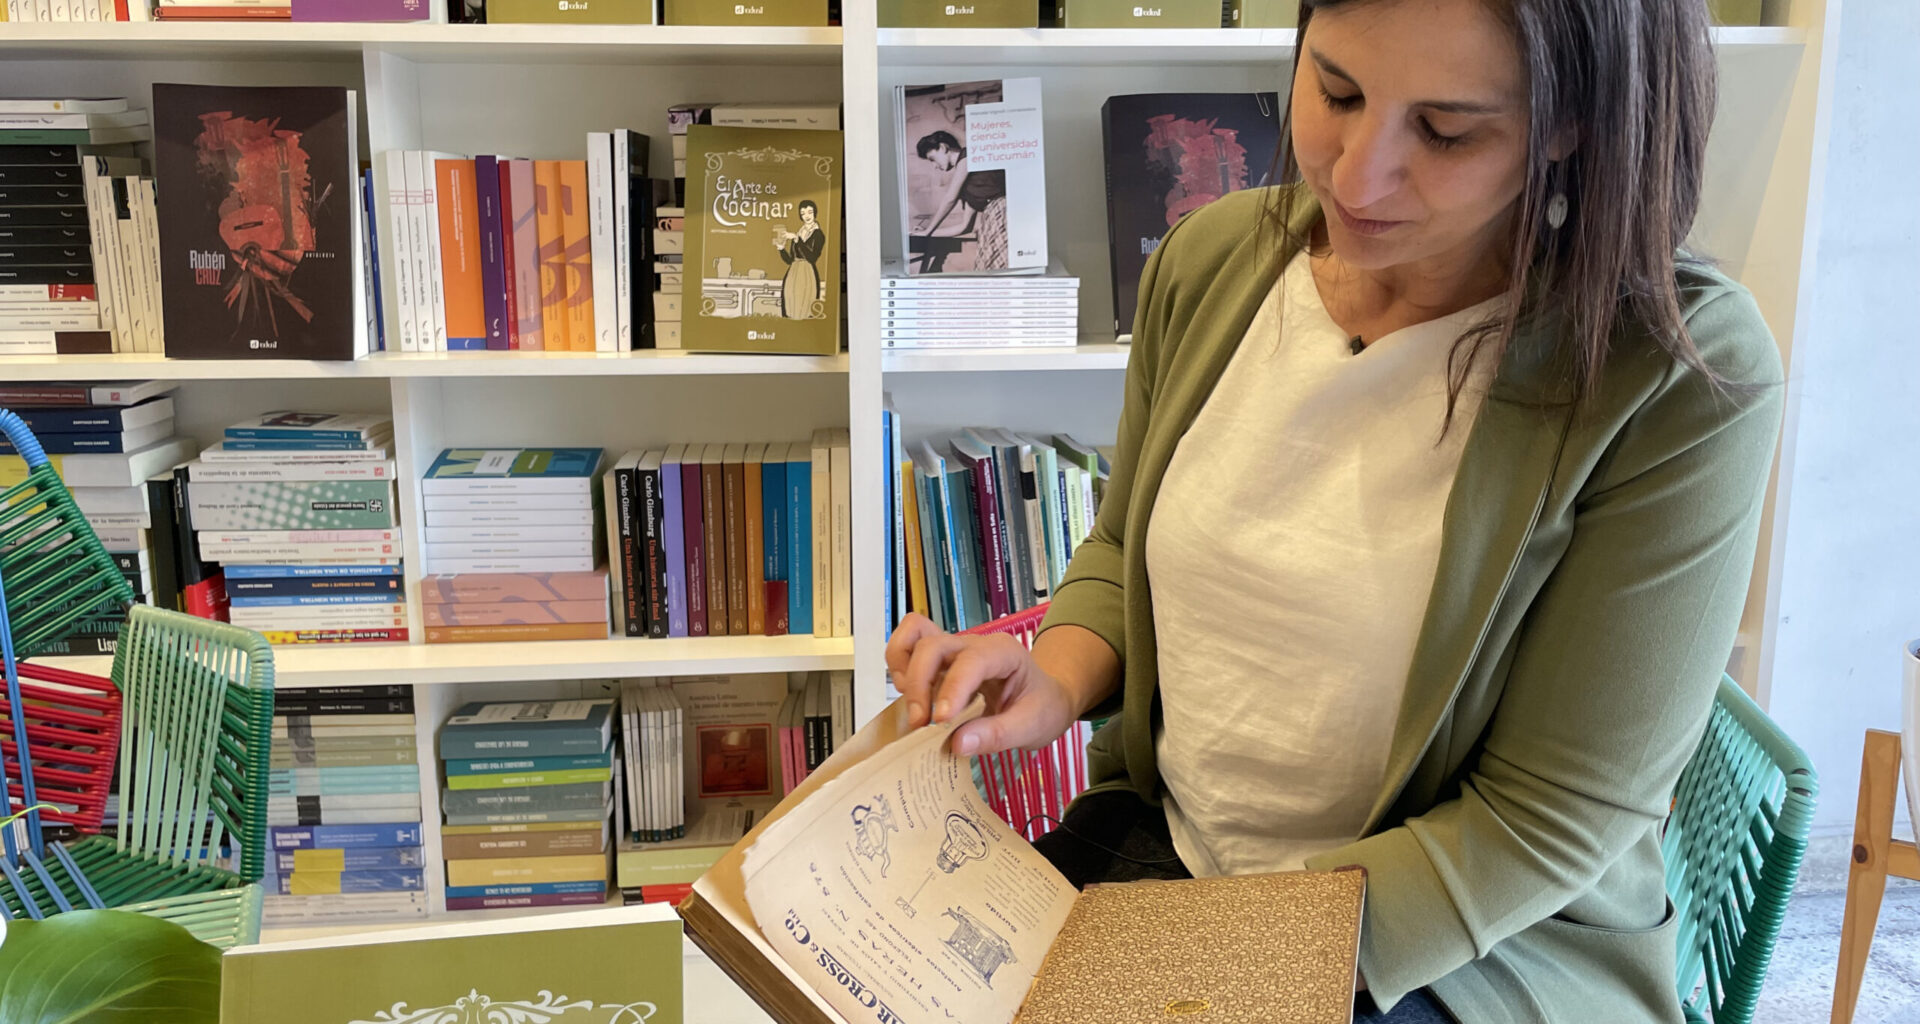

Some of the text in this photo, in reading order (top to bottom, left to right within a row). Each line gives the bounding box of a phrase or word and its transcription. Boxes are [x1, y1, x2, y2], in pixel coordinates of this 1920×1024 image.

[970, 120, 1013, 131] Mujeres,
[971, 132, 1007, 142] ciencia
[971, 139, 1038, 154] y universidad
[971, 151, 1036, 163] en Tucumán
[716, 175, 777, 200] El Arte de
[713, 192, 793, 227] Cocinar
[1141, 237, 1162, 254] Rub
[189, 250, 226, 270] Rubén
[195, 269, 222, 286] CRUZ
[645, 475, 653, 499] Carlo
[646, 498, 655, 538] Ginzburg
[620, 474, 637, 619] Carlo Ginzburg Una historia sin final
[649, 539, 657, 556] Una
[650, 556, 658, 588] historia
[994, 560, 1002, 584] Industria
[652, 602, 661, 621] final
[97, 638, 118, 653] Lisp
[897, 780, 915, 829] Completo
[875, 911, 885, 921] de
[985, 902, 1018, 933] Surtido
[785, 918, 811, 944] Co
[888, 923, 923, 956] eléctricos
[810, 942, 819, 953] &
[858, 929, 923, 990] HERAS
[816, 953, 877, 1008] CROSS
[926, 957, 962, 992] Artefactos
